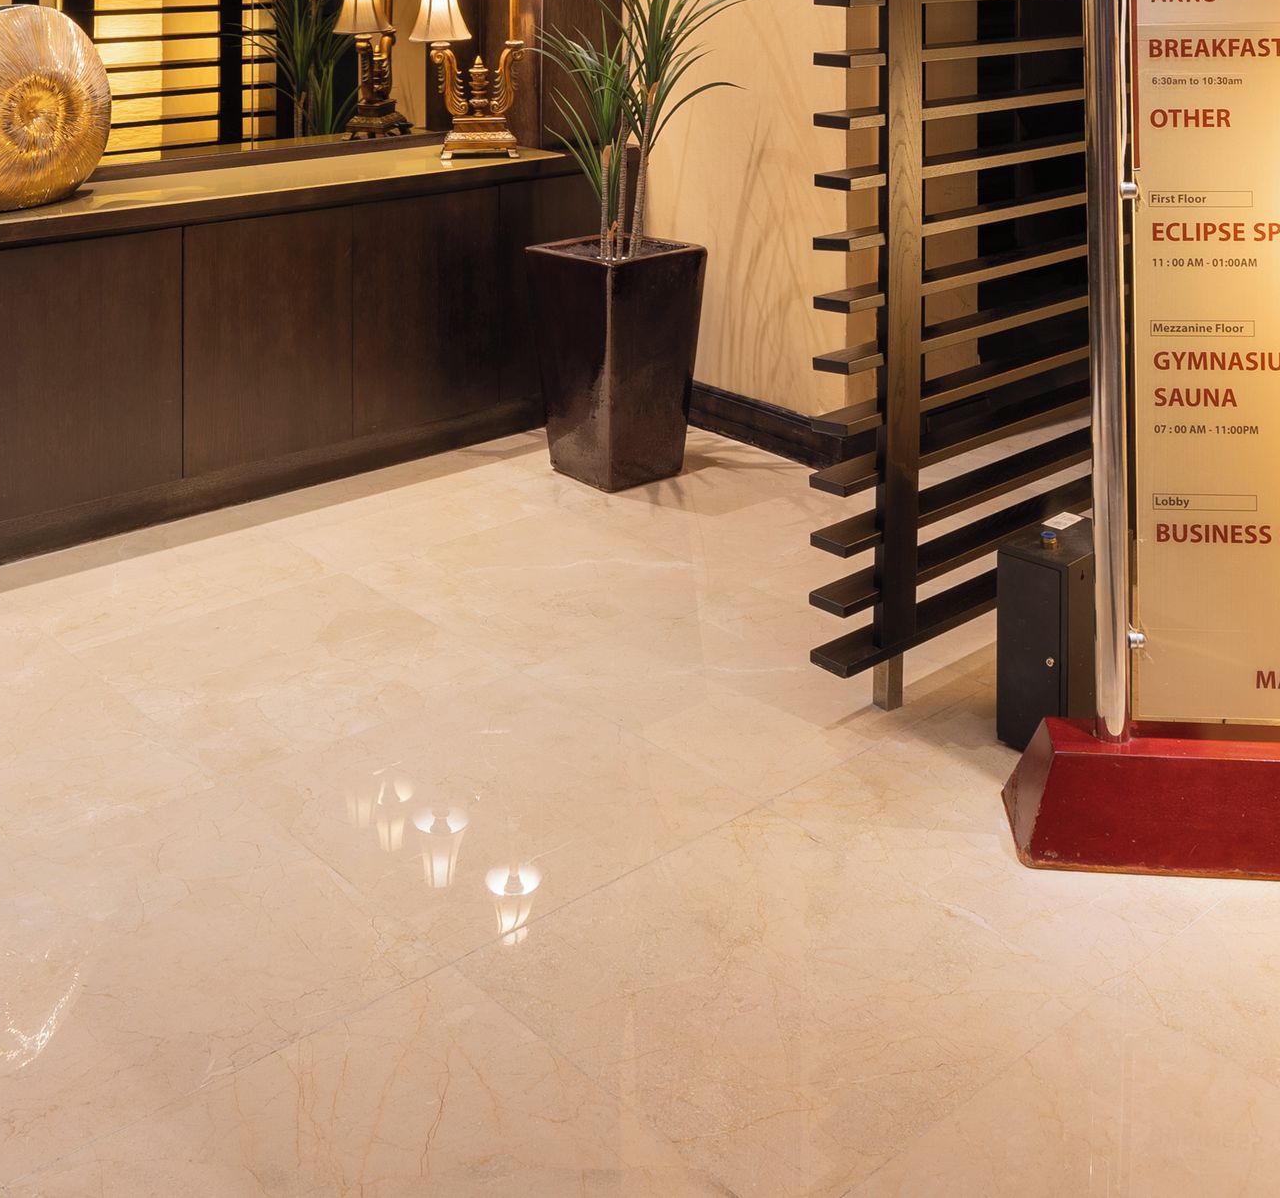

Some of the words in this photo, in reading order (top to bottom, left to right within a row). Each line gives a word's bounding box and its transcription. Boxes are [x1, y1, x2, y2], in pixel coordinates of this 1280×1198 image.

[1151, 76, 1187, 86] 6:30am
[1188, 77, 1200, 86] to
[1201, 76, 1243, 86] 10:30am
[1149, 108, 1231, 129] OTHER
[1151, 193, 1175, 204] First
[1178, 193, 1208, 204] Floor
[1151, 222, 1246, 242] ECLIPSE
[1186, 257, 1204, 267] AM
[1211, 257, 1258, 268] 01:00AM
[1153, 322, 1212, 335] Mezzanine
[1214, 322, 1245, 335] Floor
[1153, 387, 1238, 408] SAUNA
[1188, 424, 1207, 435] AM
[1214, 425, 1259, 435] 11:00PM
[1155, 496, 1191, 510] Lobby
[1156, 523, 1273, 545] BUSINESS
